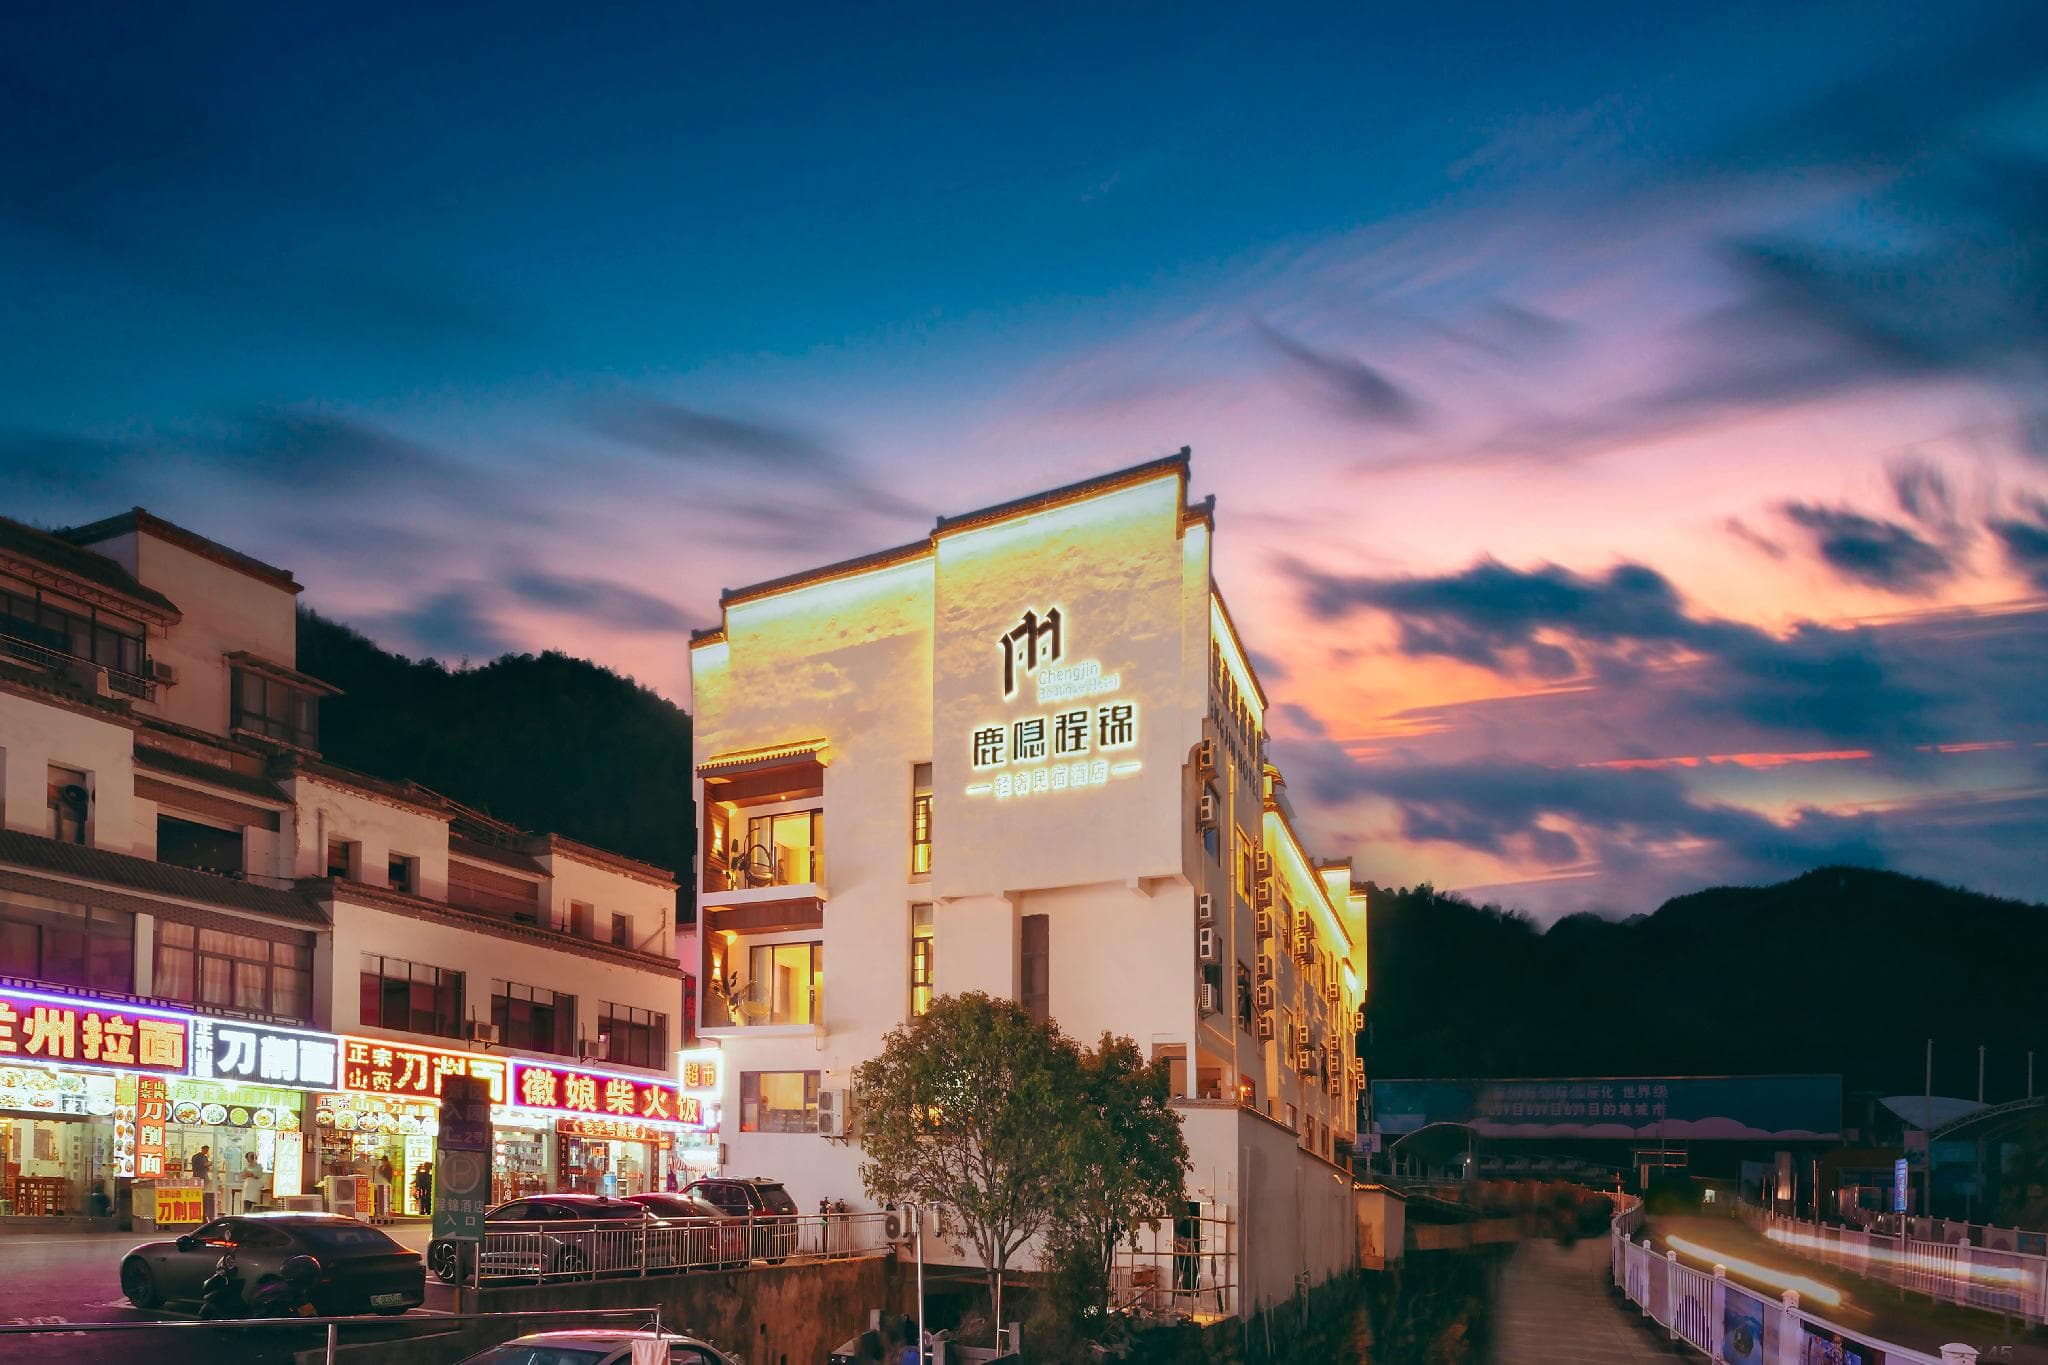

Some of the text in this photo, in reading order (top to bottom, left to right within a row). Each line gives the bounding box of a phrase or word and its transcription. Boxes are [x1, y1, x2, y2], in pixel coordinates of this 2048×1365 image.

[973, 704, 1133, 767] 鹿隐程锦
[347, 1043, 393, 1067] 正宗
[348, 1068, 393, 1091] 山西
[686, 1063, 716, 1087] 超市
[522, 1068, 698, 1123] 徽娘柴火饭
[140, 1102, 163, 1174] 刀削面
[444, 1215, 476, 1226] 入口
